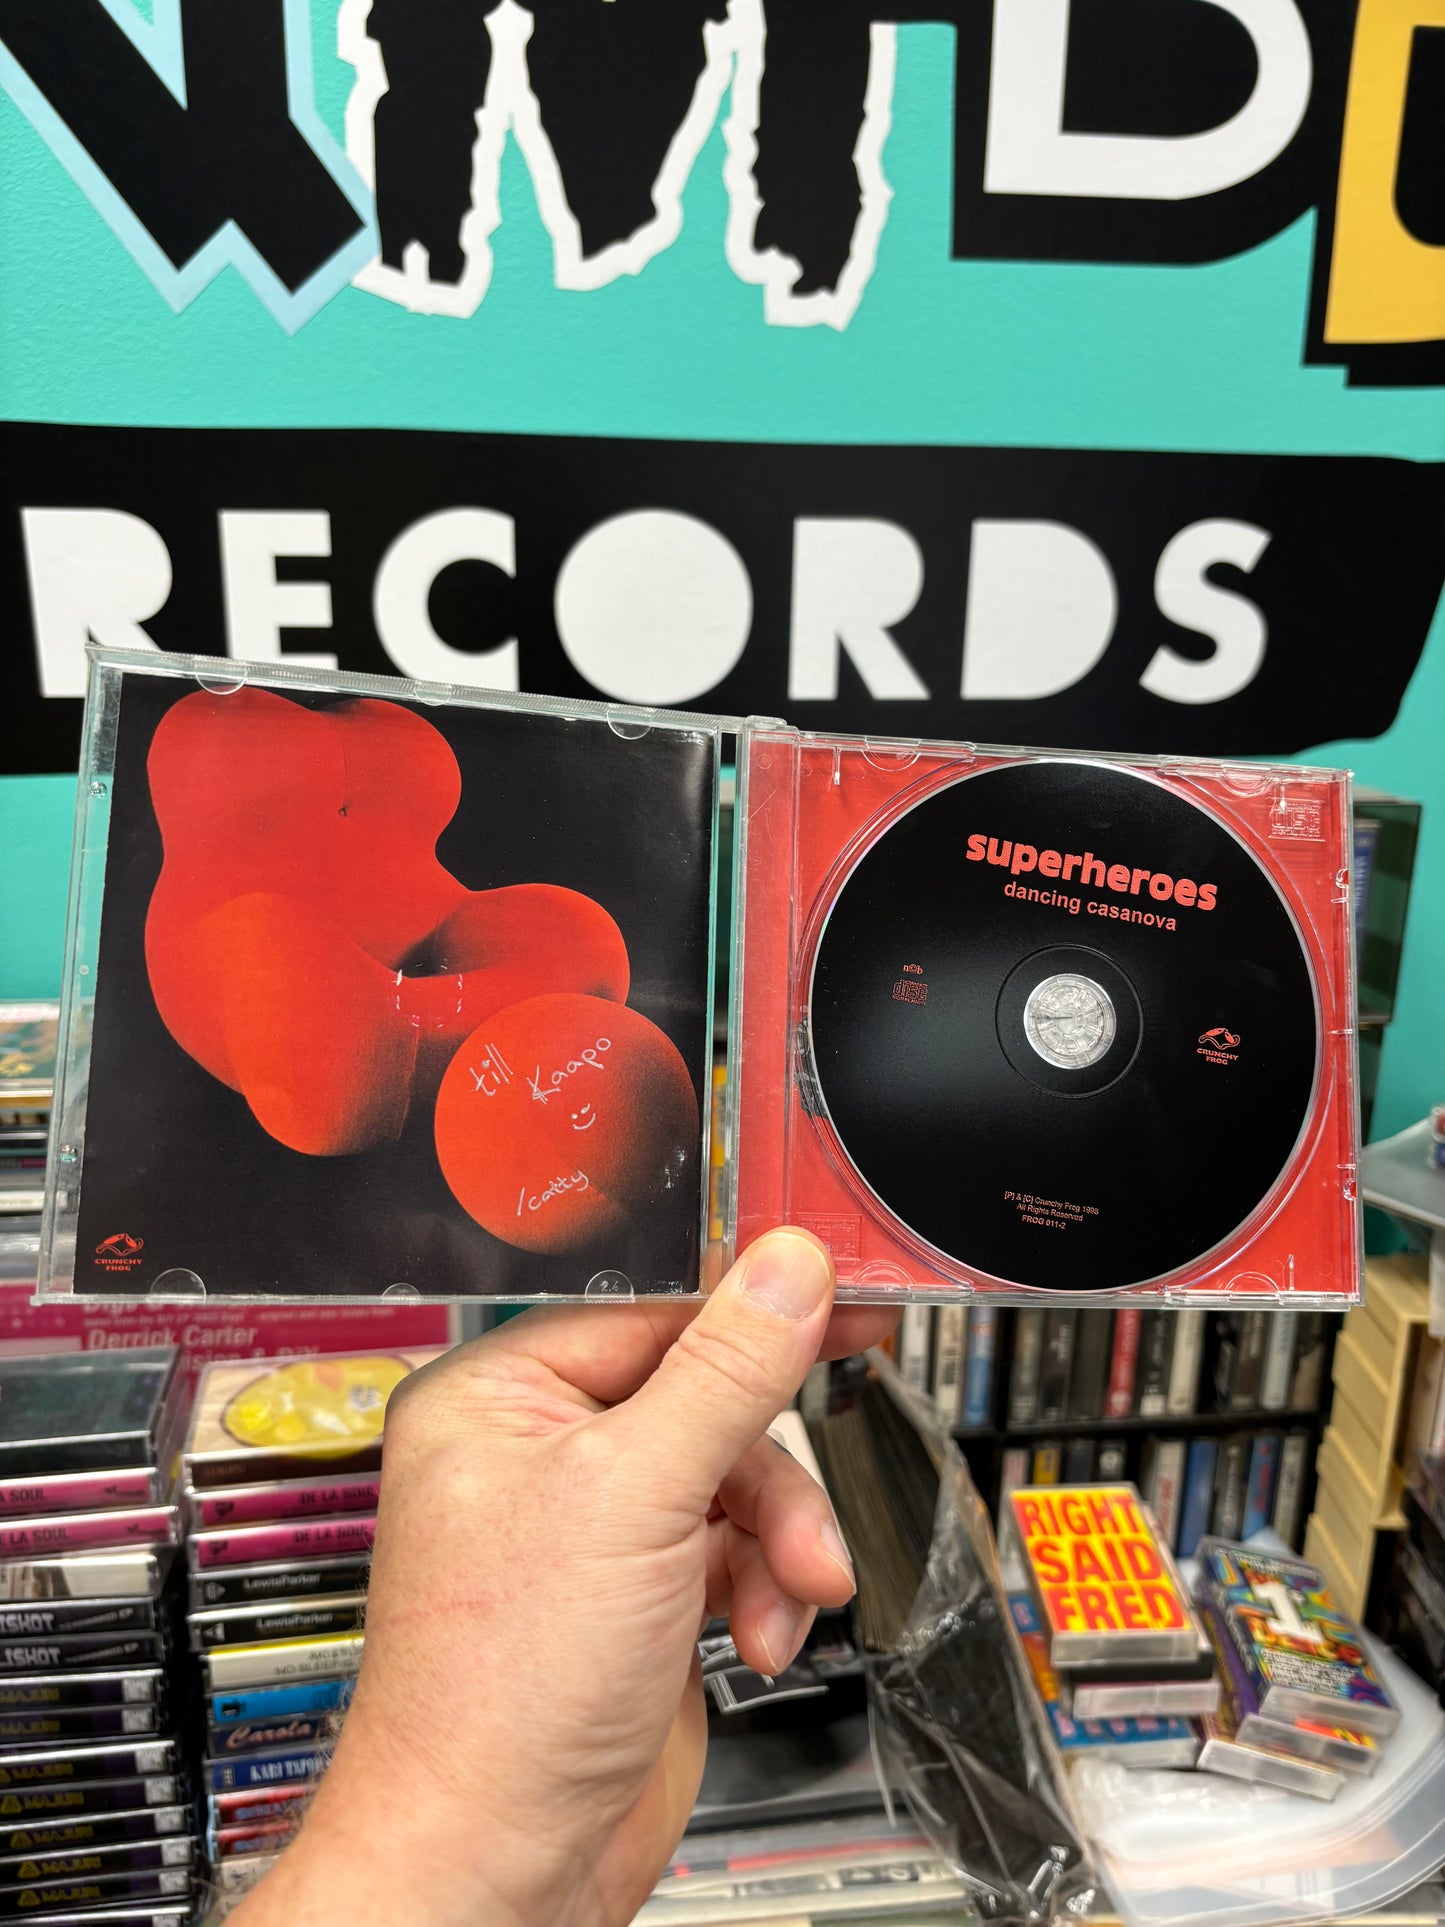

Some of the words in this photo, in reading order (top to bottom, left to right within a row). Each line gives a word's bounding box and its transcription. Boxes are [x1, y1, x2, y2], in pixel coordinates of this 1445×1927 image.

[21, 505, 1273, 706] RECORDS
[965, 833, 1218, 911] superheroes
[1003, 881, 1081, 915] dancing
[1086, 900, 1177, 931] casanova
[526, 1037, 612, 1105] Kaapo
[1197, 1047, 1239, 1061] CRUNCHY
[1206, 1055, 1228, 1065] FROG
[1016, 1202, 1026, 1211] All
[1027, 1203, 1049, 1216] Rights
[1050, 1208, 1084, 1222] Reserved
[1021, 1213, 1045, 1226] FROG
[1034, 1196, 1064, 1210] Crunchy
[1064, 1201, 1081, 1213] Frog
[88, 1325, 177, 1350] Derrick
[182, 1324, 259, 1347] Carter
[1012, 1495, 1140, 1537] RIGHT
[1033, 1539, 1162, 1583] SAID
[1047, 1585, 1184, 1630] FRED
